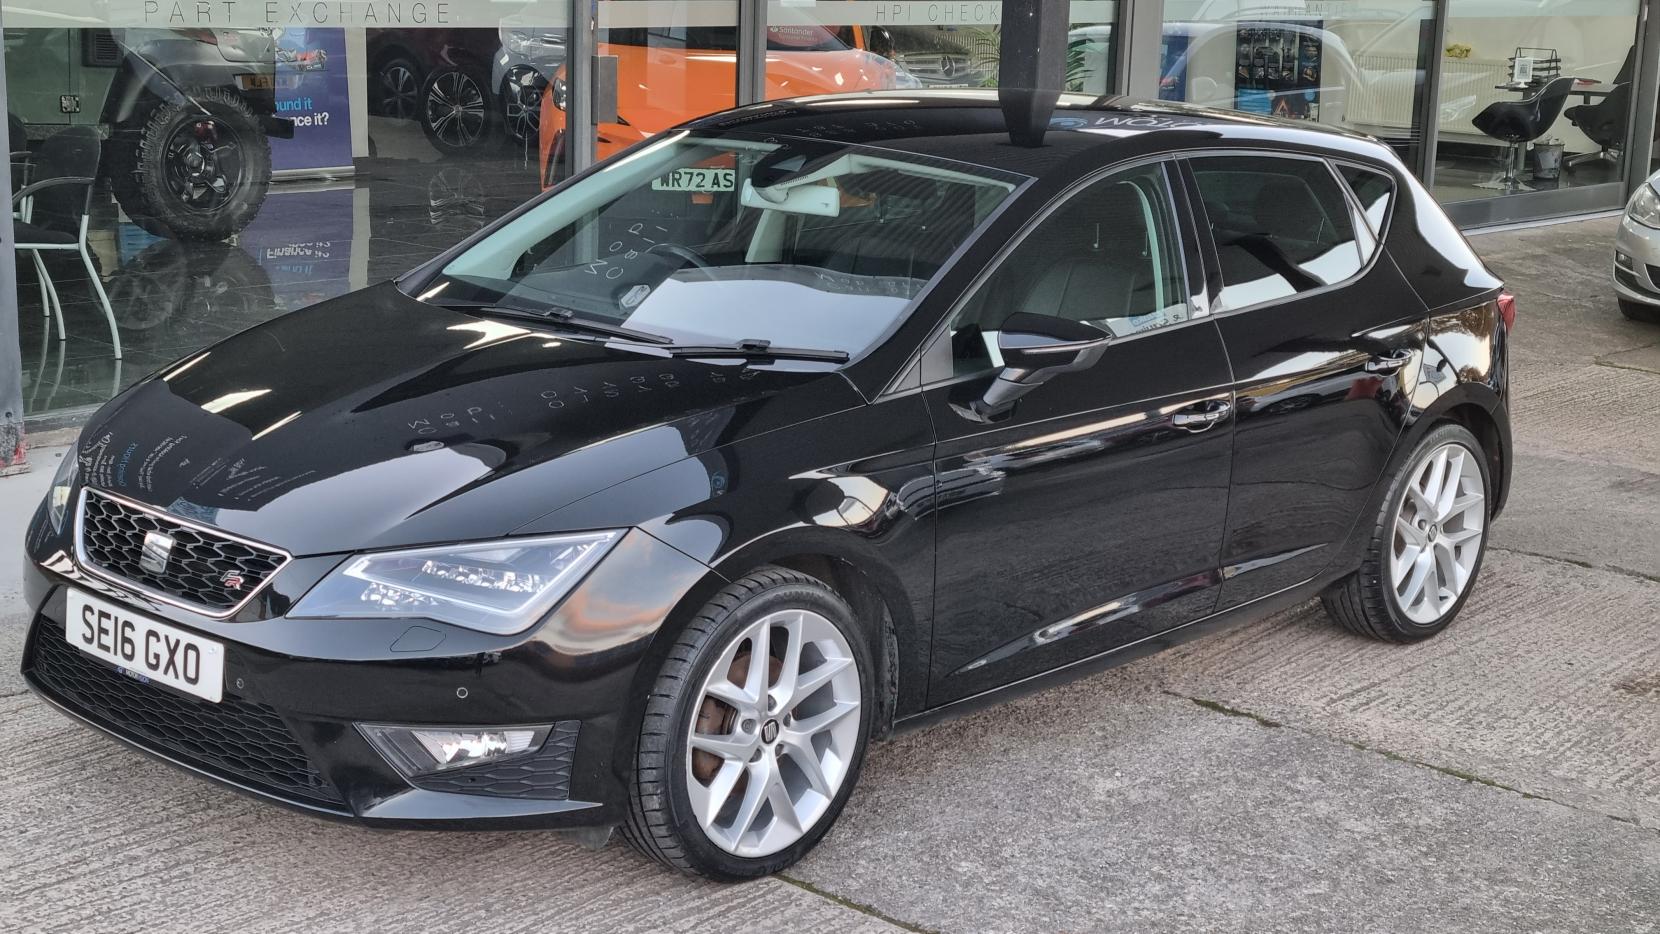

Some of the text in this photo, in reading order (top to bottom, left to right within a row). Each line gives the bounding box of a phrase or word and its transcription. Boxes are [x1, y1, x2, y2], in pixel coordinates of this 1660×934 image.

[144, 1, 449, 23] PART EXCHANGE
[876, 4, 999, 22] HPI CHECK
[313, 112, 329, 126] it?
[660, 171, 734, 188] WR72 AS
[82, 604, 200, 686] SE16 GXO
